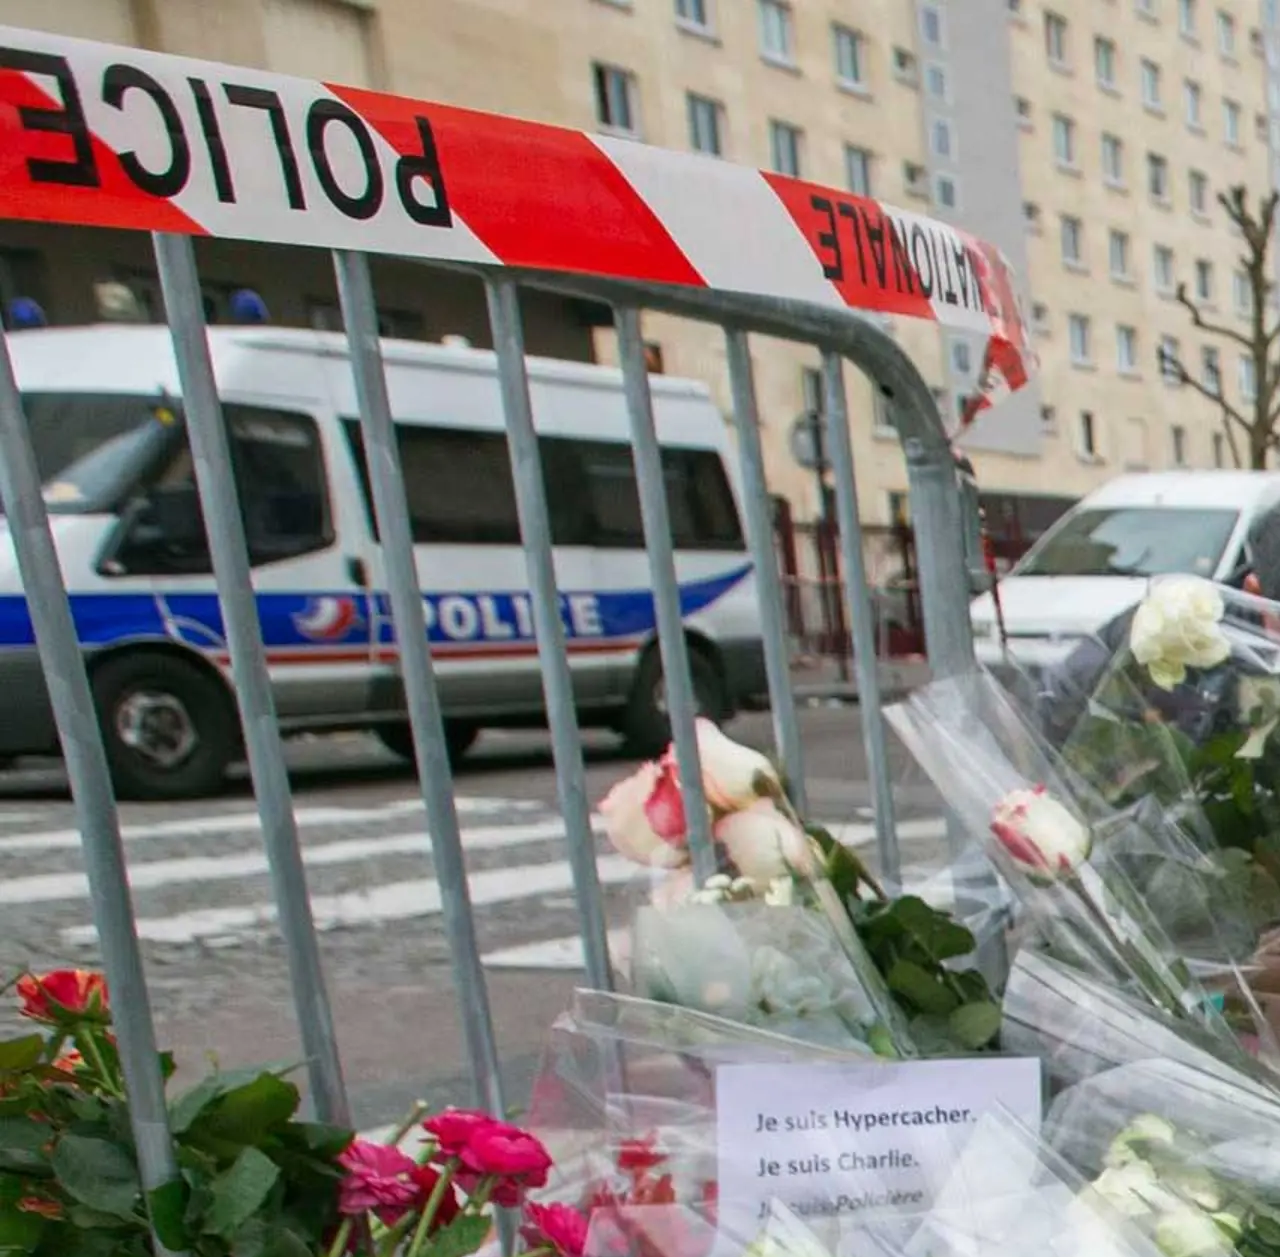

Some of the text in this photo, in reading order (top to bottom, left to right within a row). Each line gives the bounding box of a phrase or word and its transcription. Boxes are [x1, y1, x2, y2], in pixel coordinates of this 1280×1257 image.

[0, 50, 454, 229] POLICE
[810, 195, 986, 314] NATIONALE
[420, 594, 603, 641] OLIE
[755, 1103, 978, 1133] Je suis Hypercacher.
[757, 1147, 920, 1177] Je suis Charlie.
